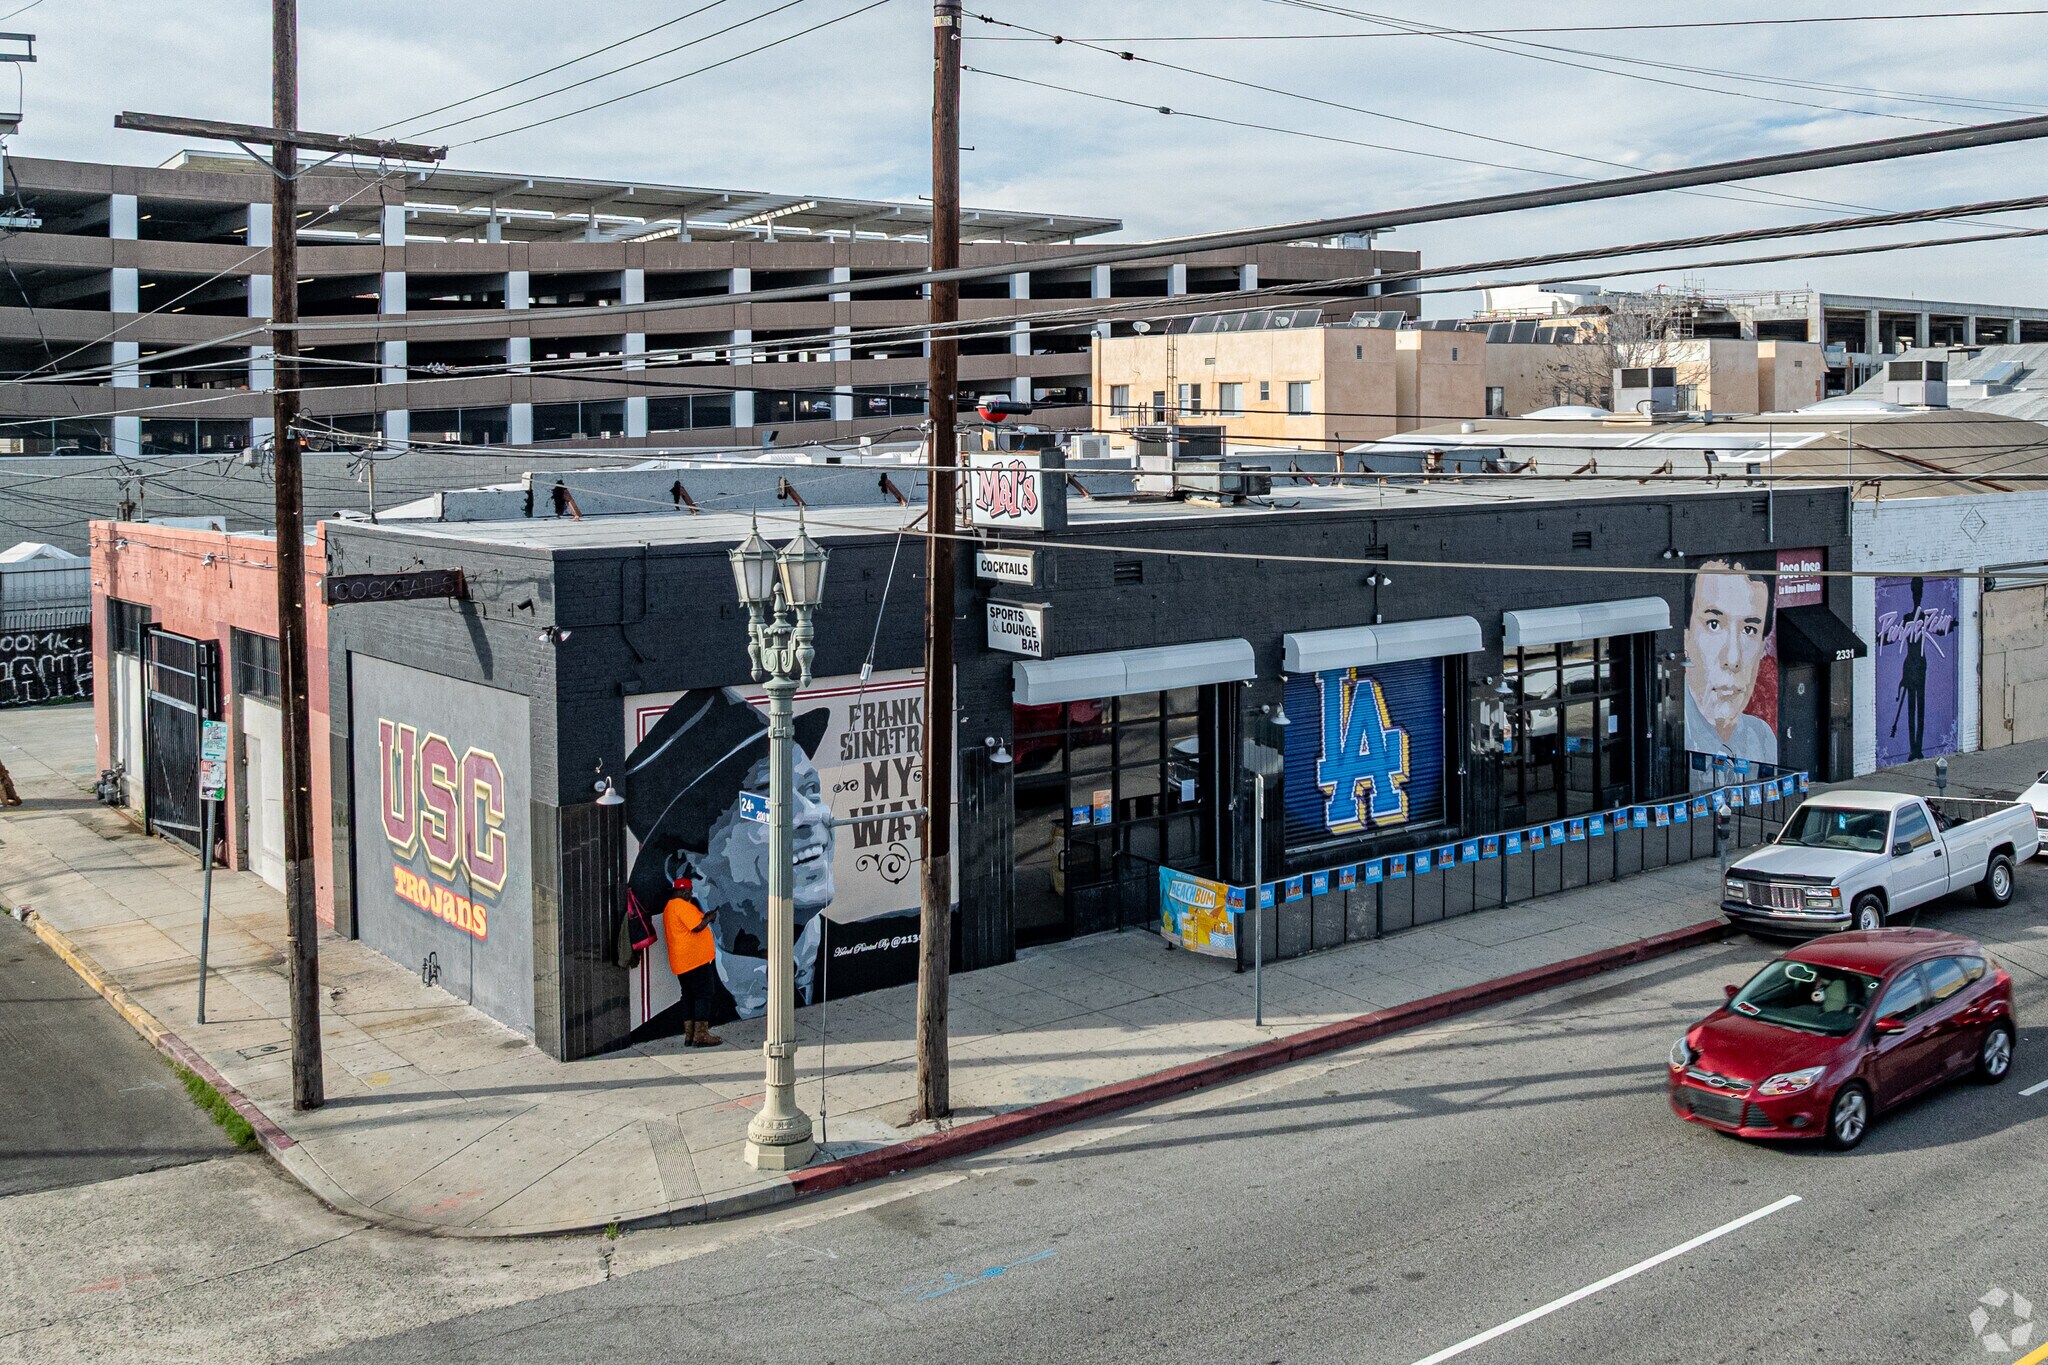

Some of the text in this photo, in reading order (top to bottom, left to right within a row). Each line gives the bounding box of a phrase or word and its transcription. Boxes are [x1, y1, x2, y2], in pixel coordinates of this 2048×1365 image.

[976, 459, 1038, 519] Mal's
[981, 560, 1028, 576] COCKTAILS
[335, 576, 455, 601] COCKTAILS
[989, 606, 1024, 622] SPORTS
[992, 619, 1037, 638] & LOUNGE
[1021, 638, 1040, 652] BAR
[1877, 605, 1953, 658] Purple Rain
[1835, 648, 1855, 661] 2331
[848, 696, 924, 733] FRANK
[840, 724, 923, 761] SINATR
[1315, 667, 1410, 835] LA
[863, 755, 916, 803] MY
[378, 717, 508, 897] USC
[877, 937, 890, 951] By
[890, 933, 922, 948] @213
